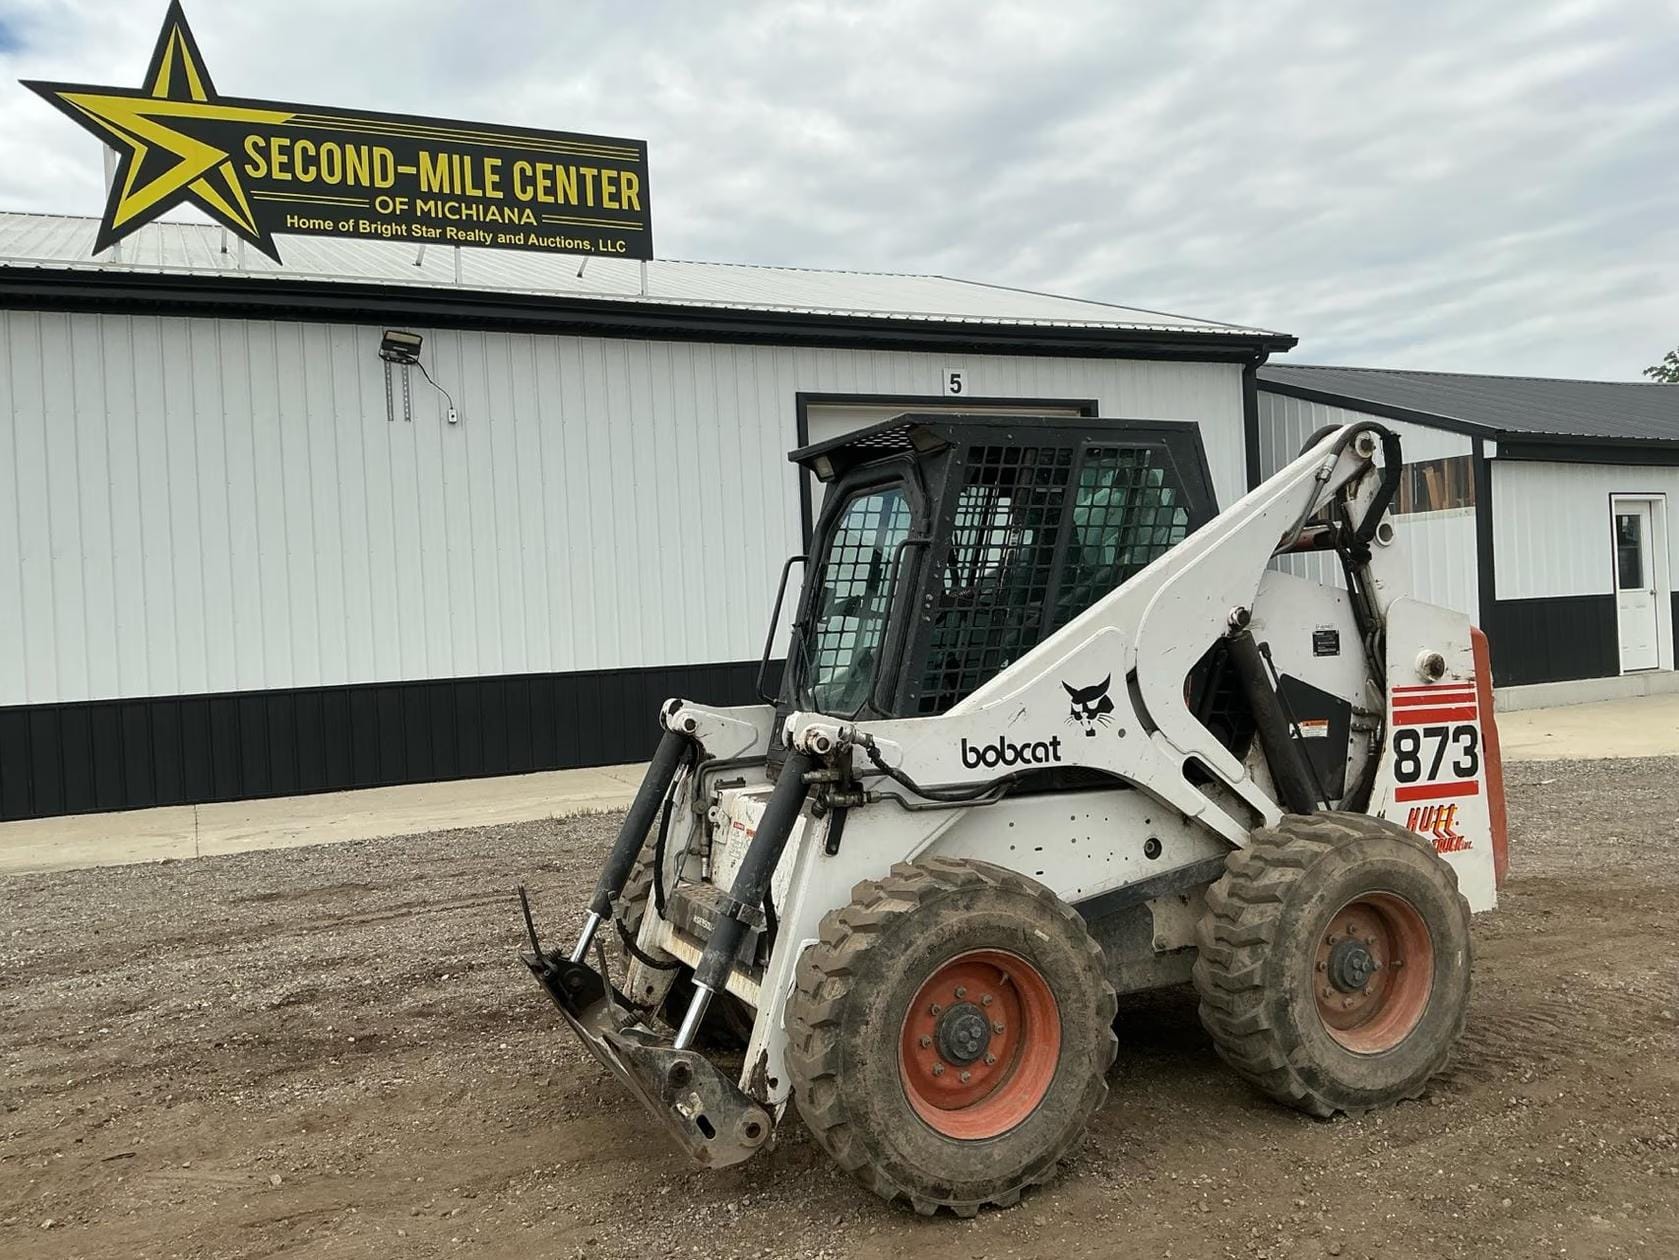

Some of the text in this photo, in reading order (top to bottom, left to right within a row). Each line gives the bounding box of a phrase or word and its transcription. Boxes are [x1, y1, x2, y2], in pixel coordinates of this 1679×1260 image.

[244, 134, 641, 211] SECOND-MILE CENTER
[375, 195, 537, 226] OF MICHIANA
[286, 214, 626, 253] Home of Bright Star Realty and Auctions, LLC
[950, 373, 962, 394] 5
[961, 736, 1061, 769] bobcat
[1393, 725, 1479, 784] 873
